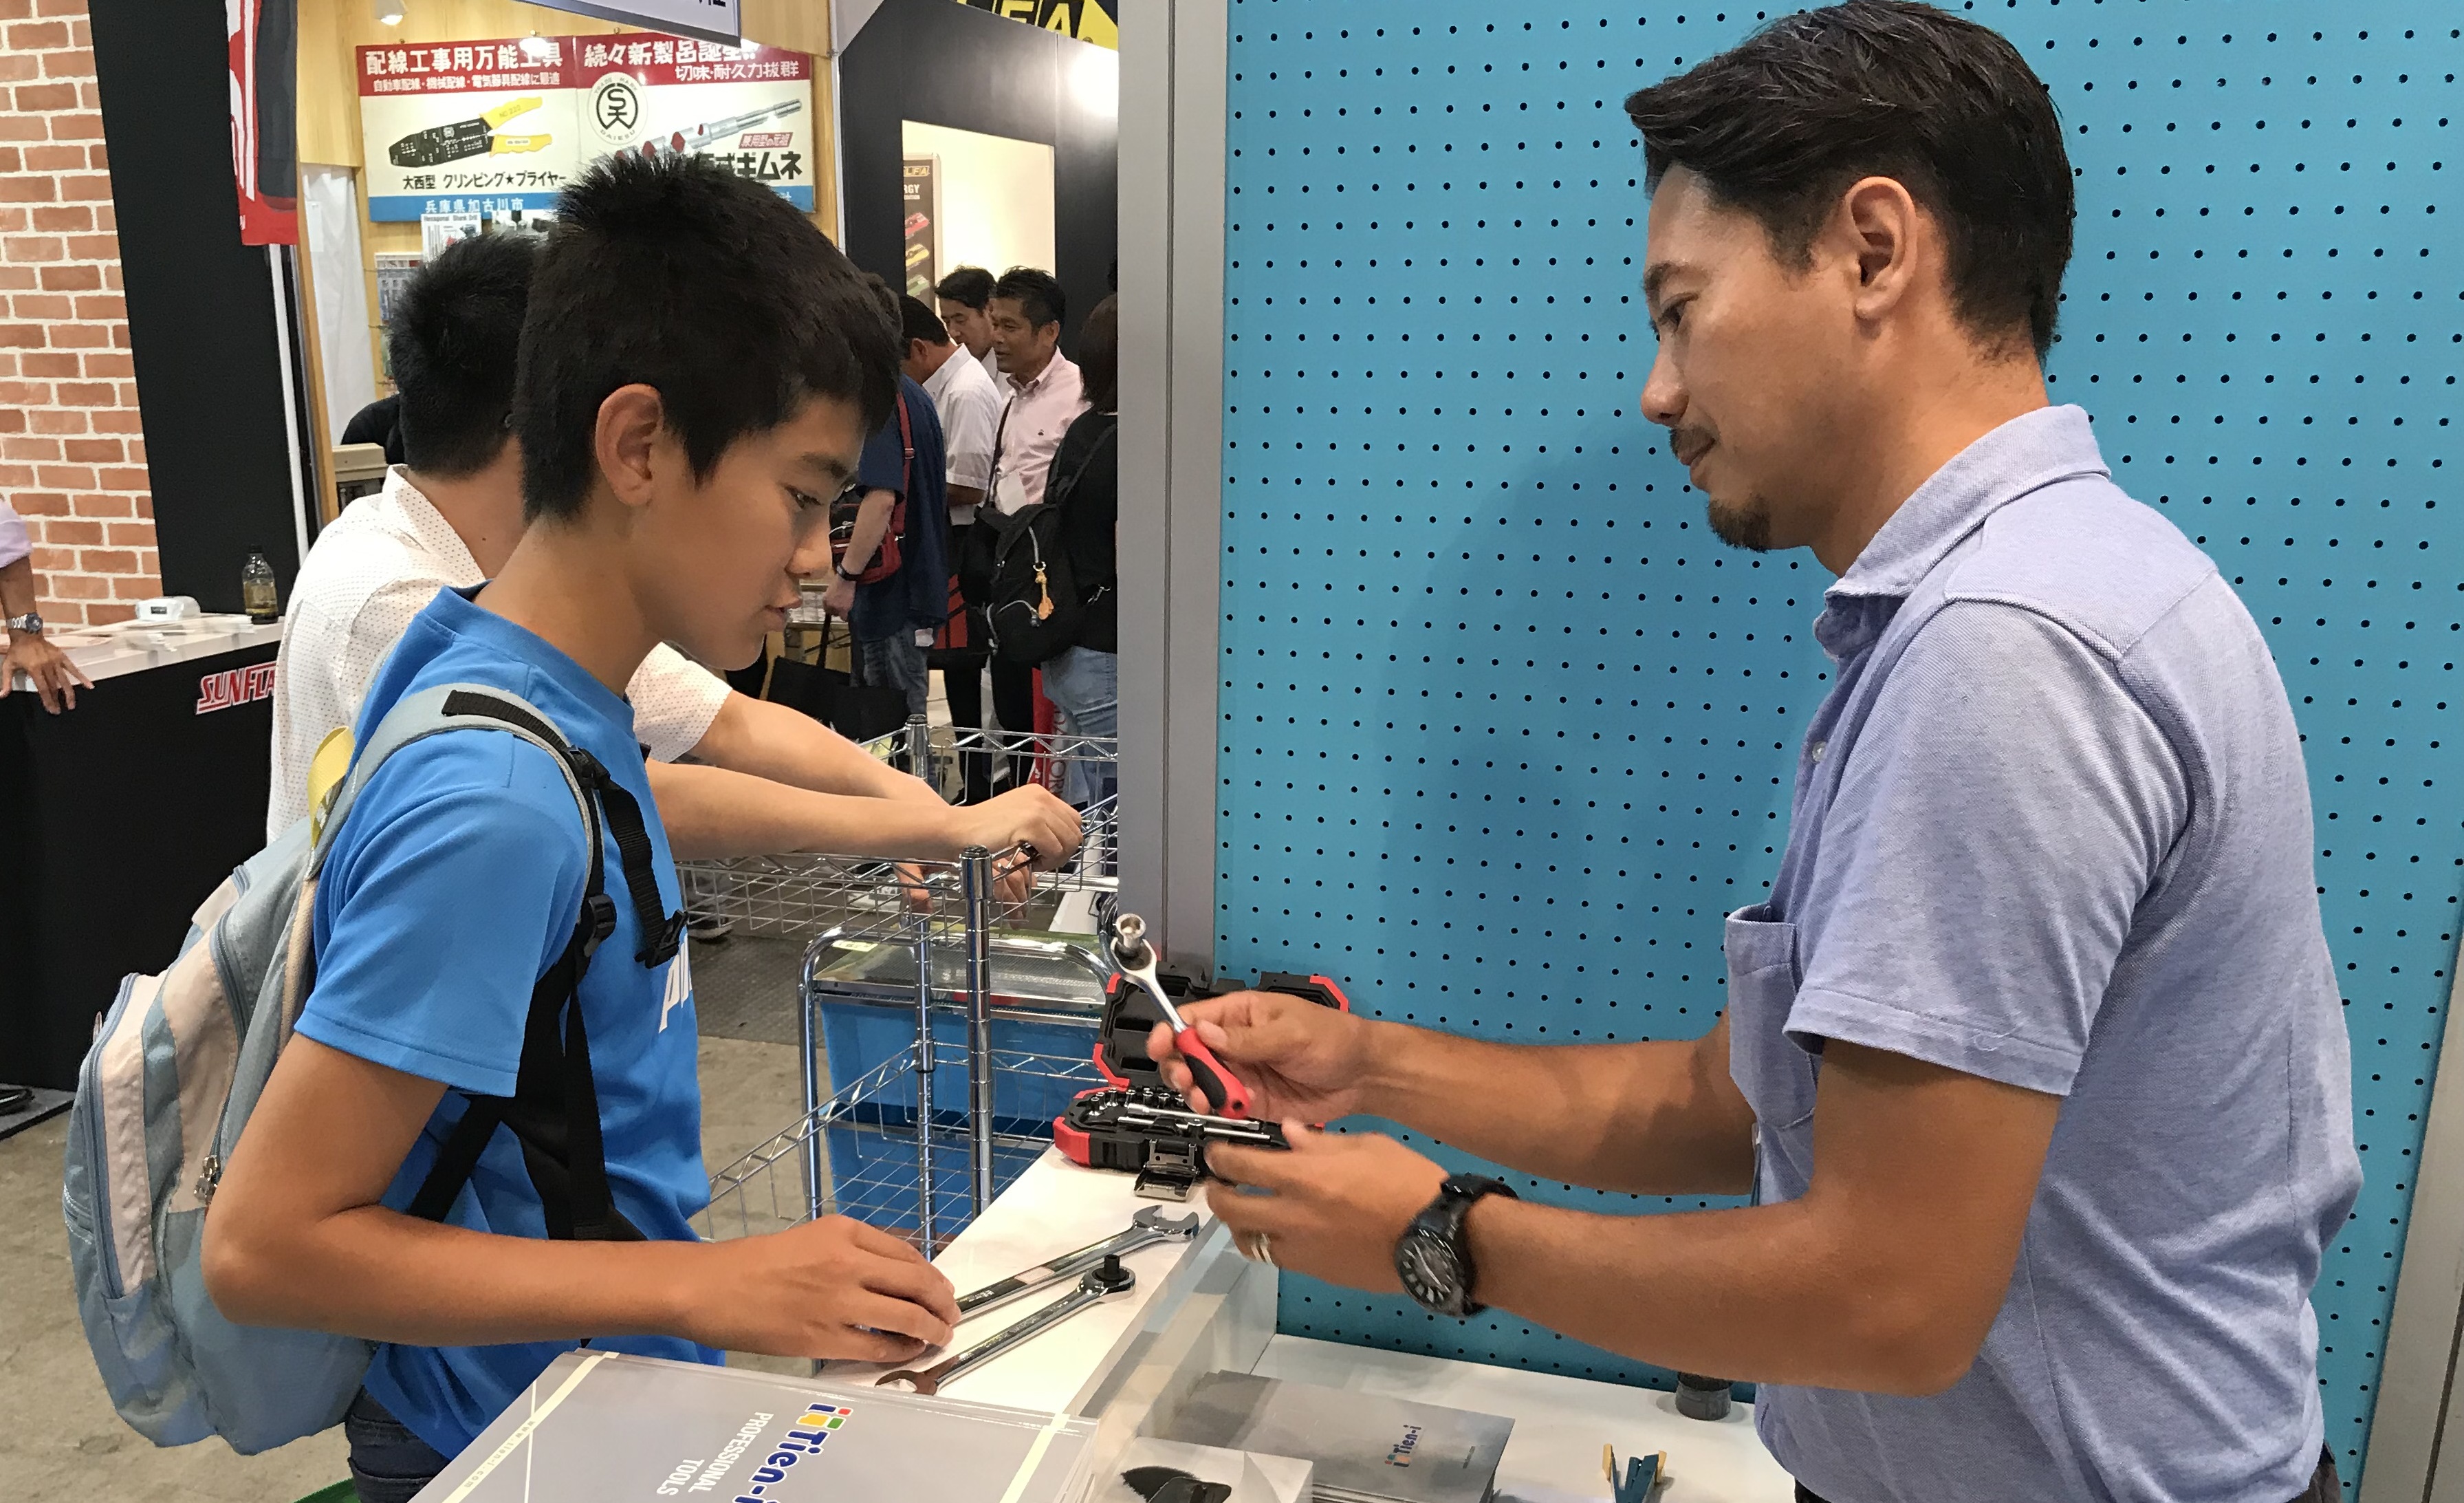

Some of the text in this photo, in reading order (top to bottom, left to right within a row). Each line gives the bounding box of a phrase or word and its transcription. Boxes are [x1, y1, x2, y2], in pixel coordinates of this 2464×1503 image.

[403, 175, 436, 190] 大西型
[425, 197, 524, 214] 兵庫県加古川市
[688, 1412, 774, 1493] PROFESSIONAL
[657, 1459, 705, 1495] TOOLS
